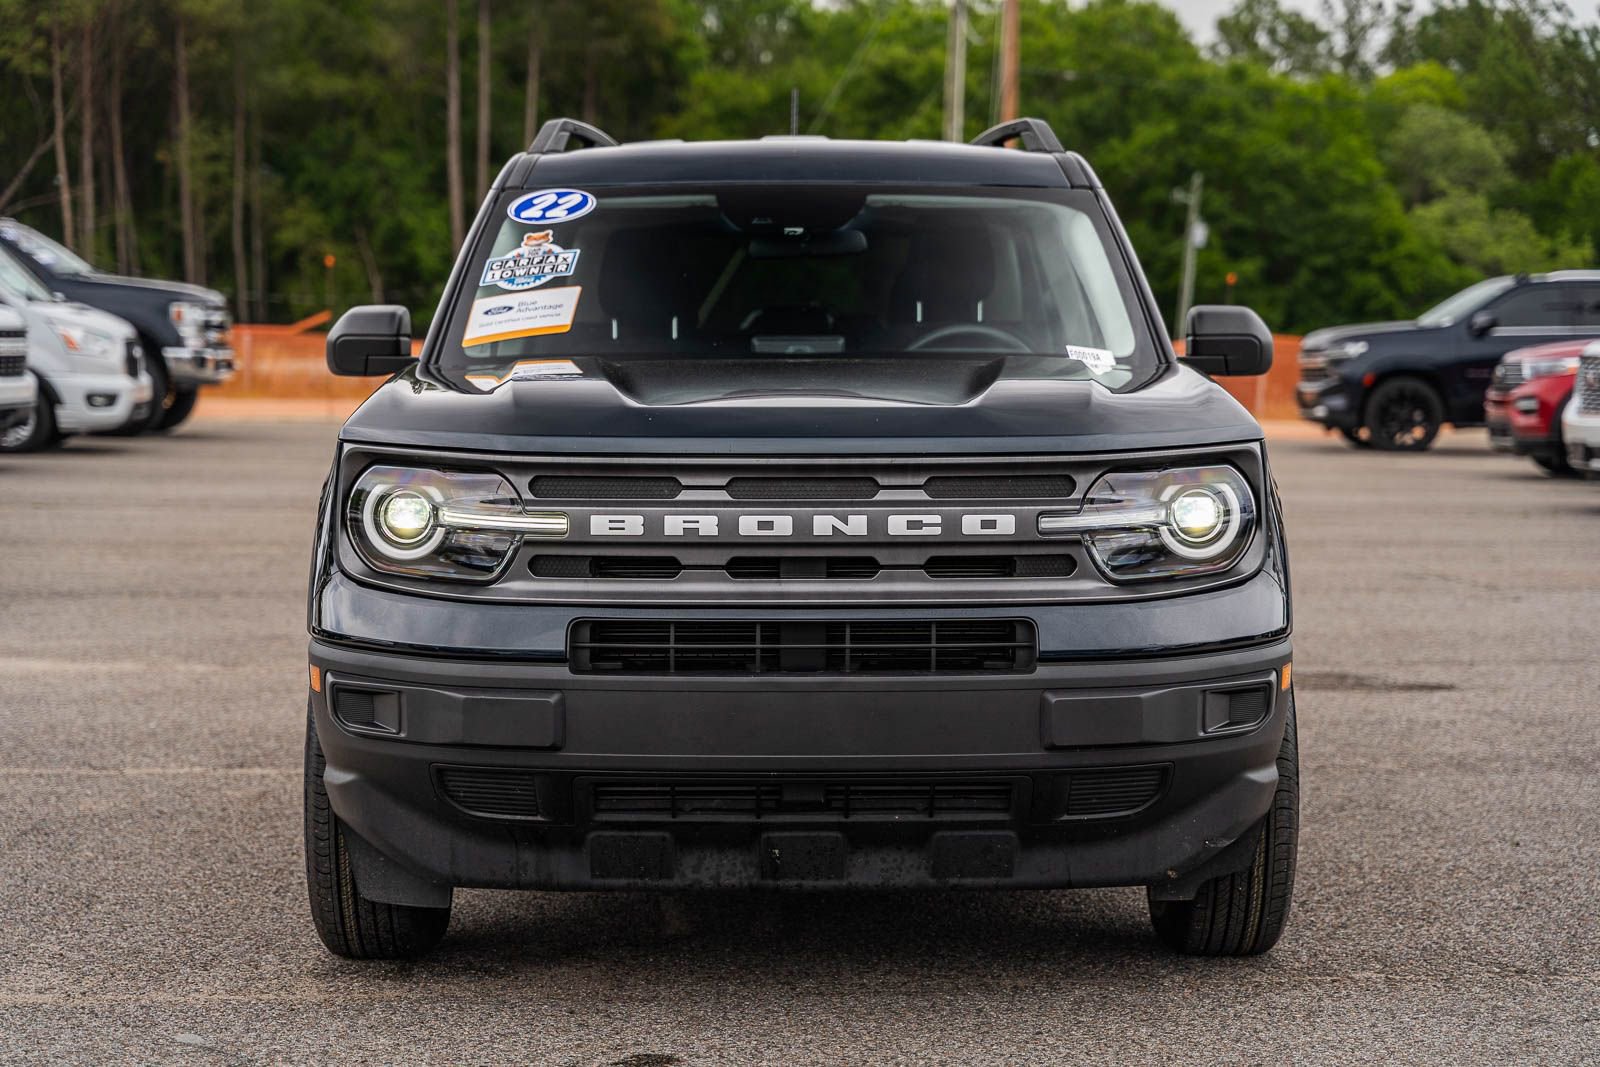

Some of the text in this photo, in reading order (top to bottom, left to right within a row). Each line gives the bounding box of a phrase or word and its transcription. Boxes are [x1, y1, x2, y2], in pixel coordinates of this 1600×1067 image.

[521, 193, 583, 218] 22
[490, 254, 571, 271] CARFAX
[501, 264, 568, 279] OWNER
[515, 303, 565, 314] Advantage
[590, 514, 1016, 536] BRONCO
